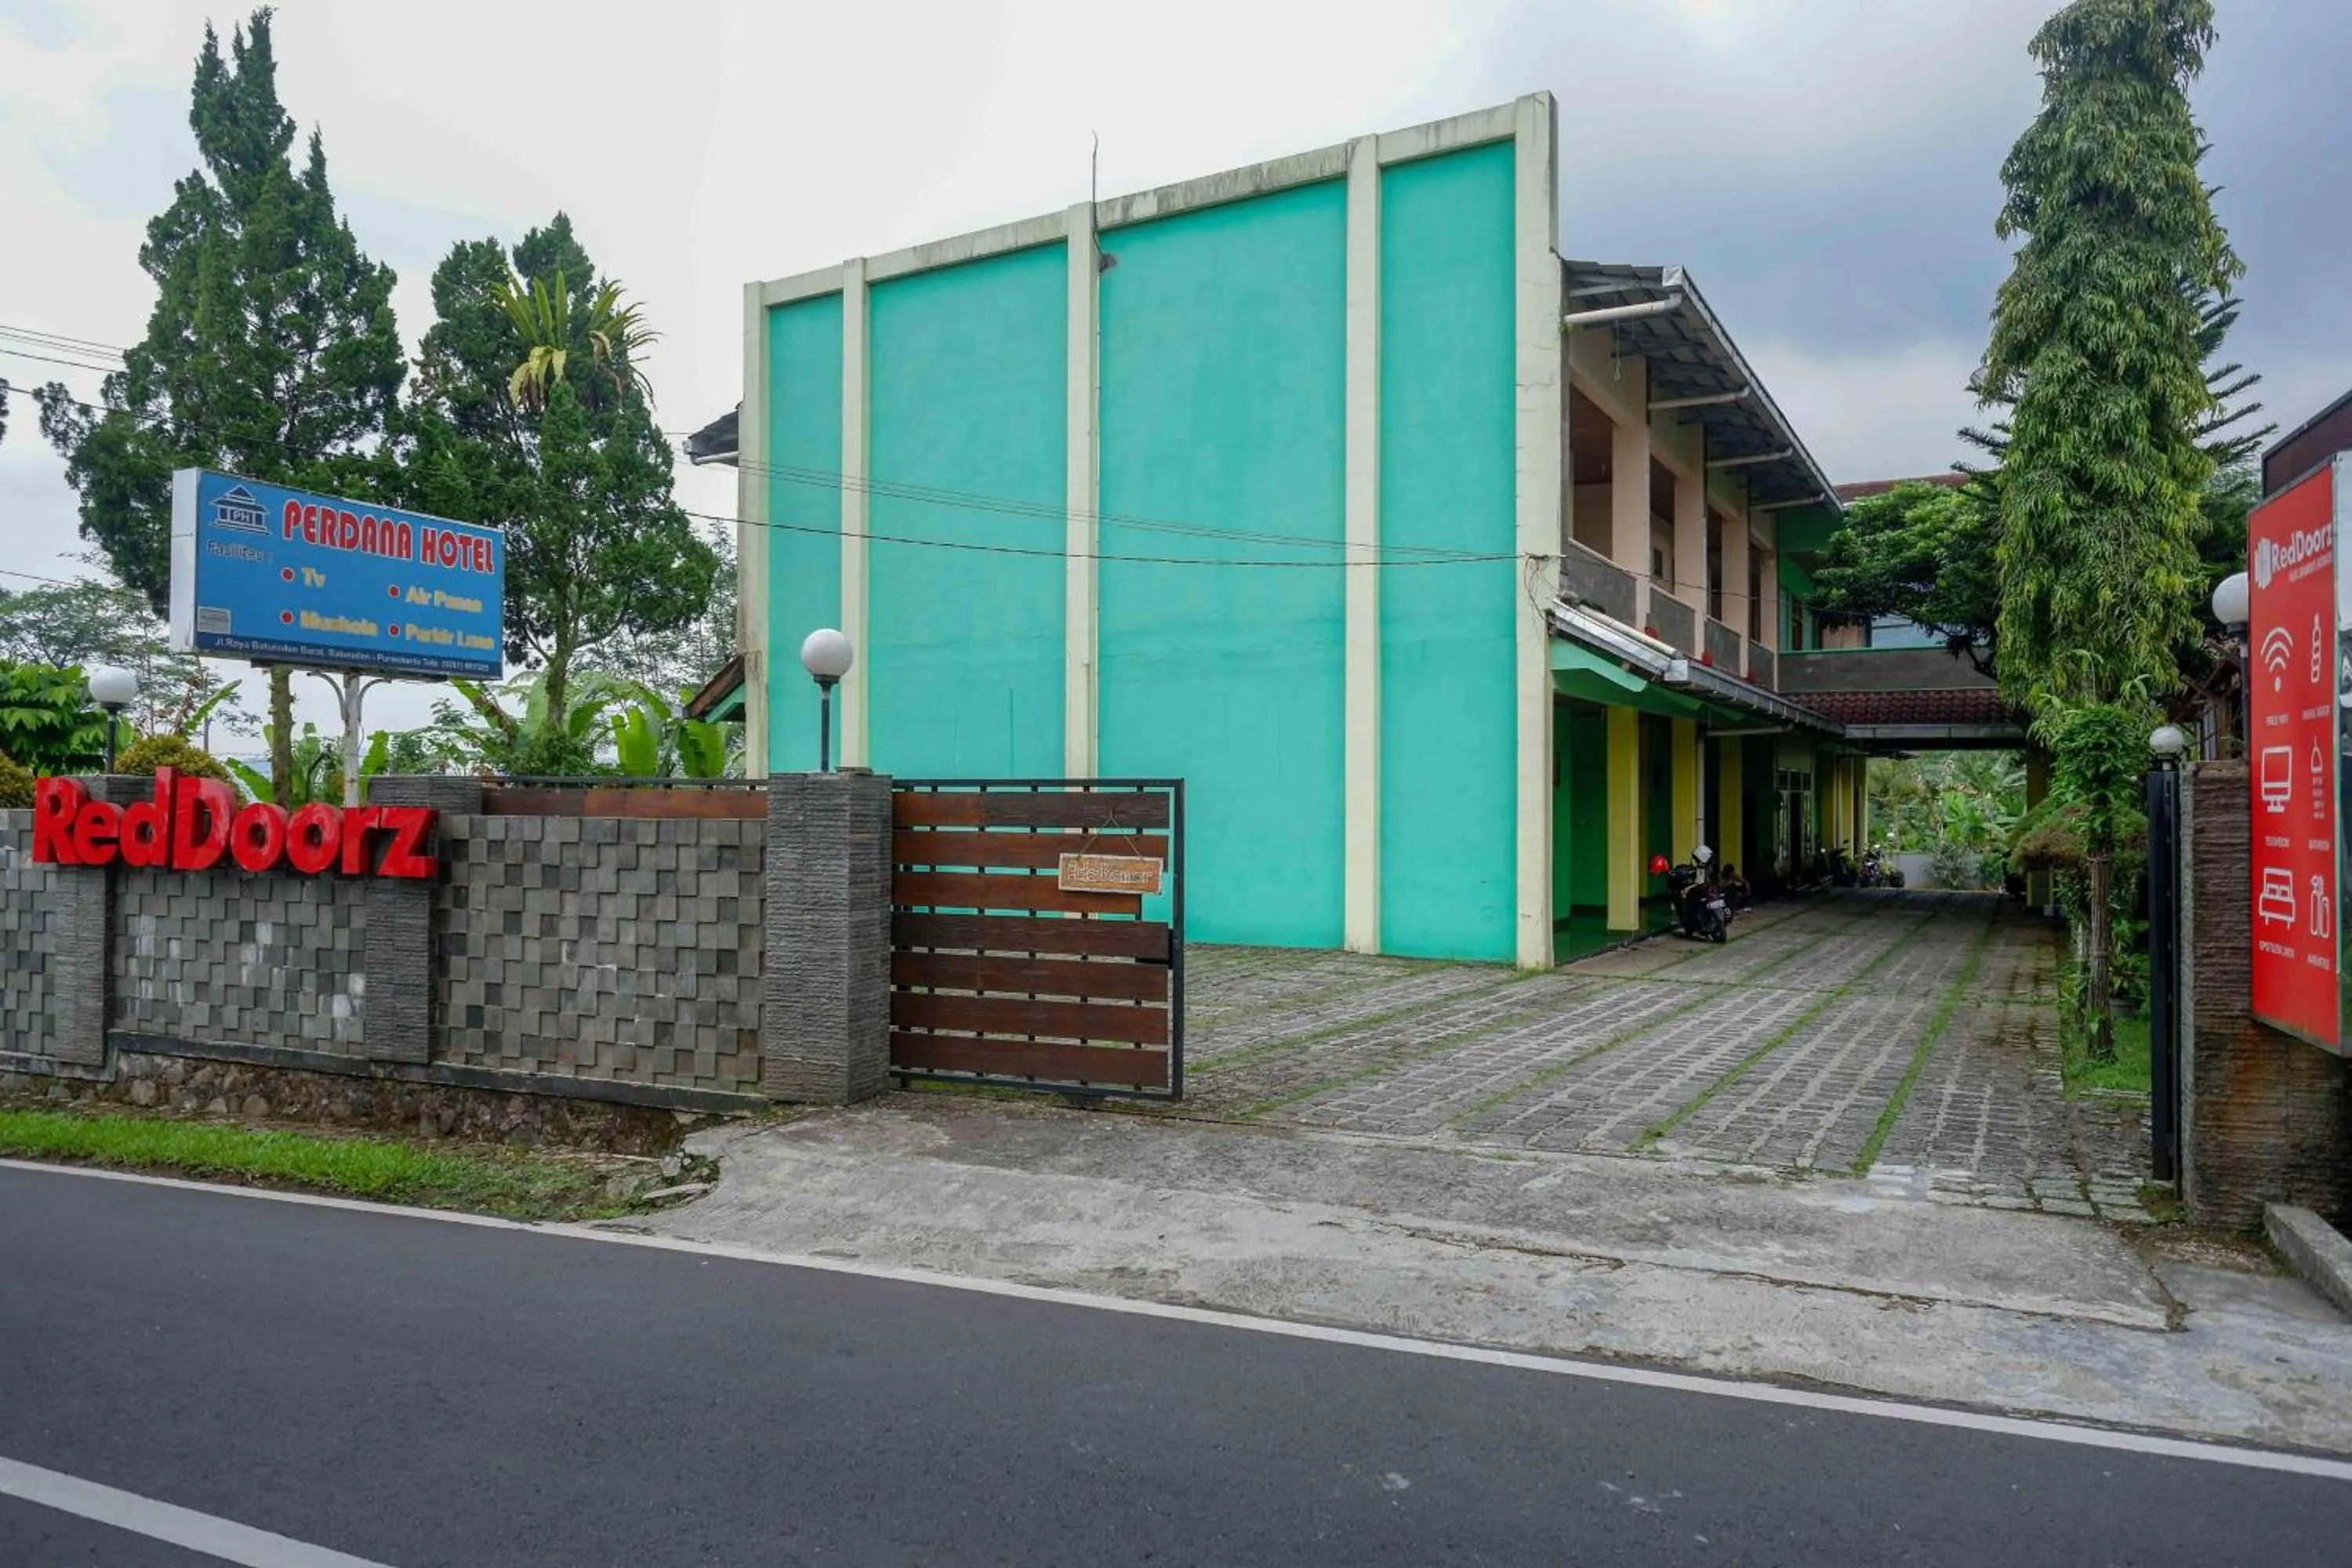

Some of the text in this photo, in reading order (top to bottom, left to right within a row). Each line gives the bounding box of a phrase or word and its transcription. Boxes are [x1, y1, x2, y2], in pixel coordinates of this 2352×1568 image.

[282, 498, 494, 574] PERDANA HOTEL
[2271, 523, 2332, 573] RedDoorz
[300, 567, 326, 588] Tv
[405, 586, 432, 605] Air
[33, 765, 439, 878] RedDoorz
